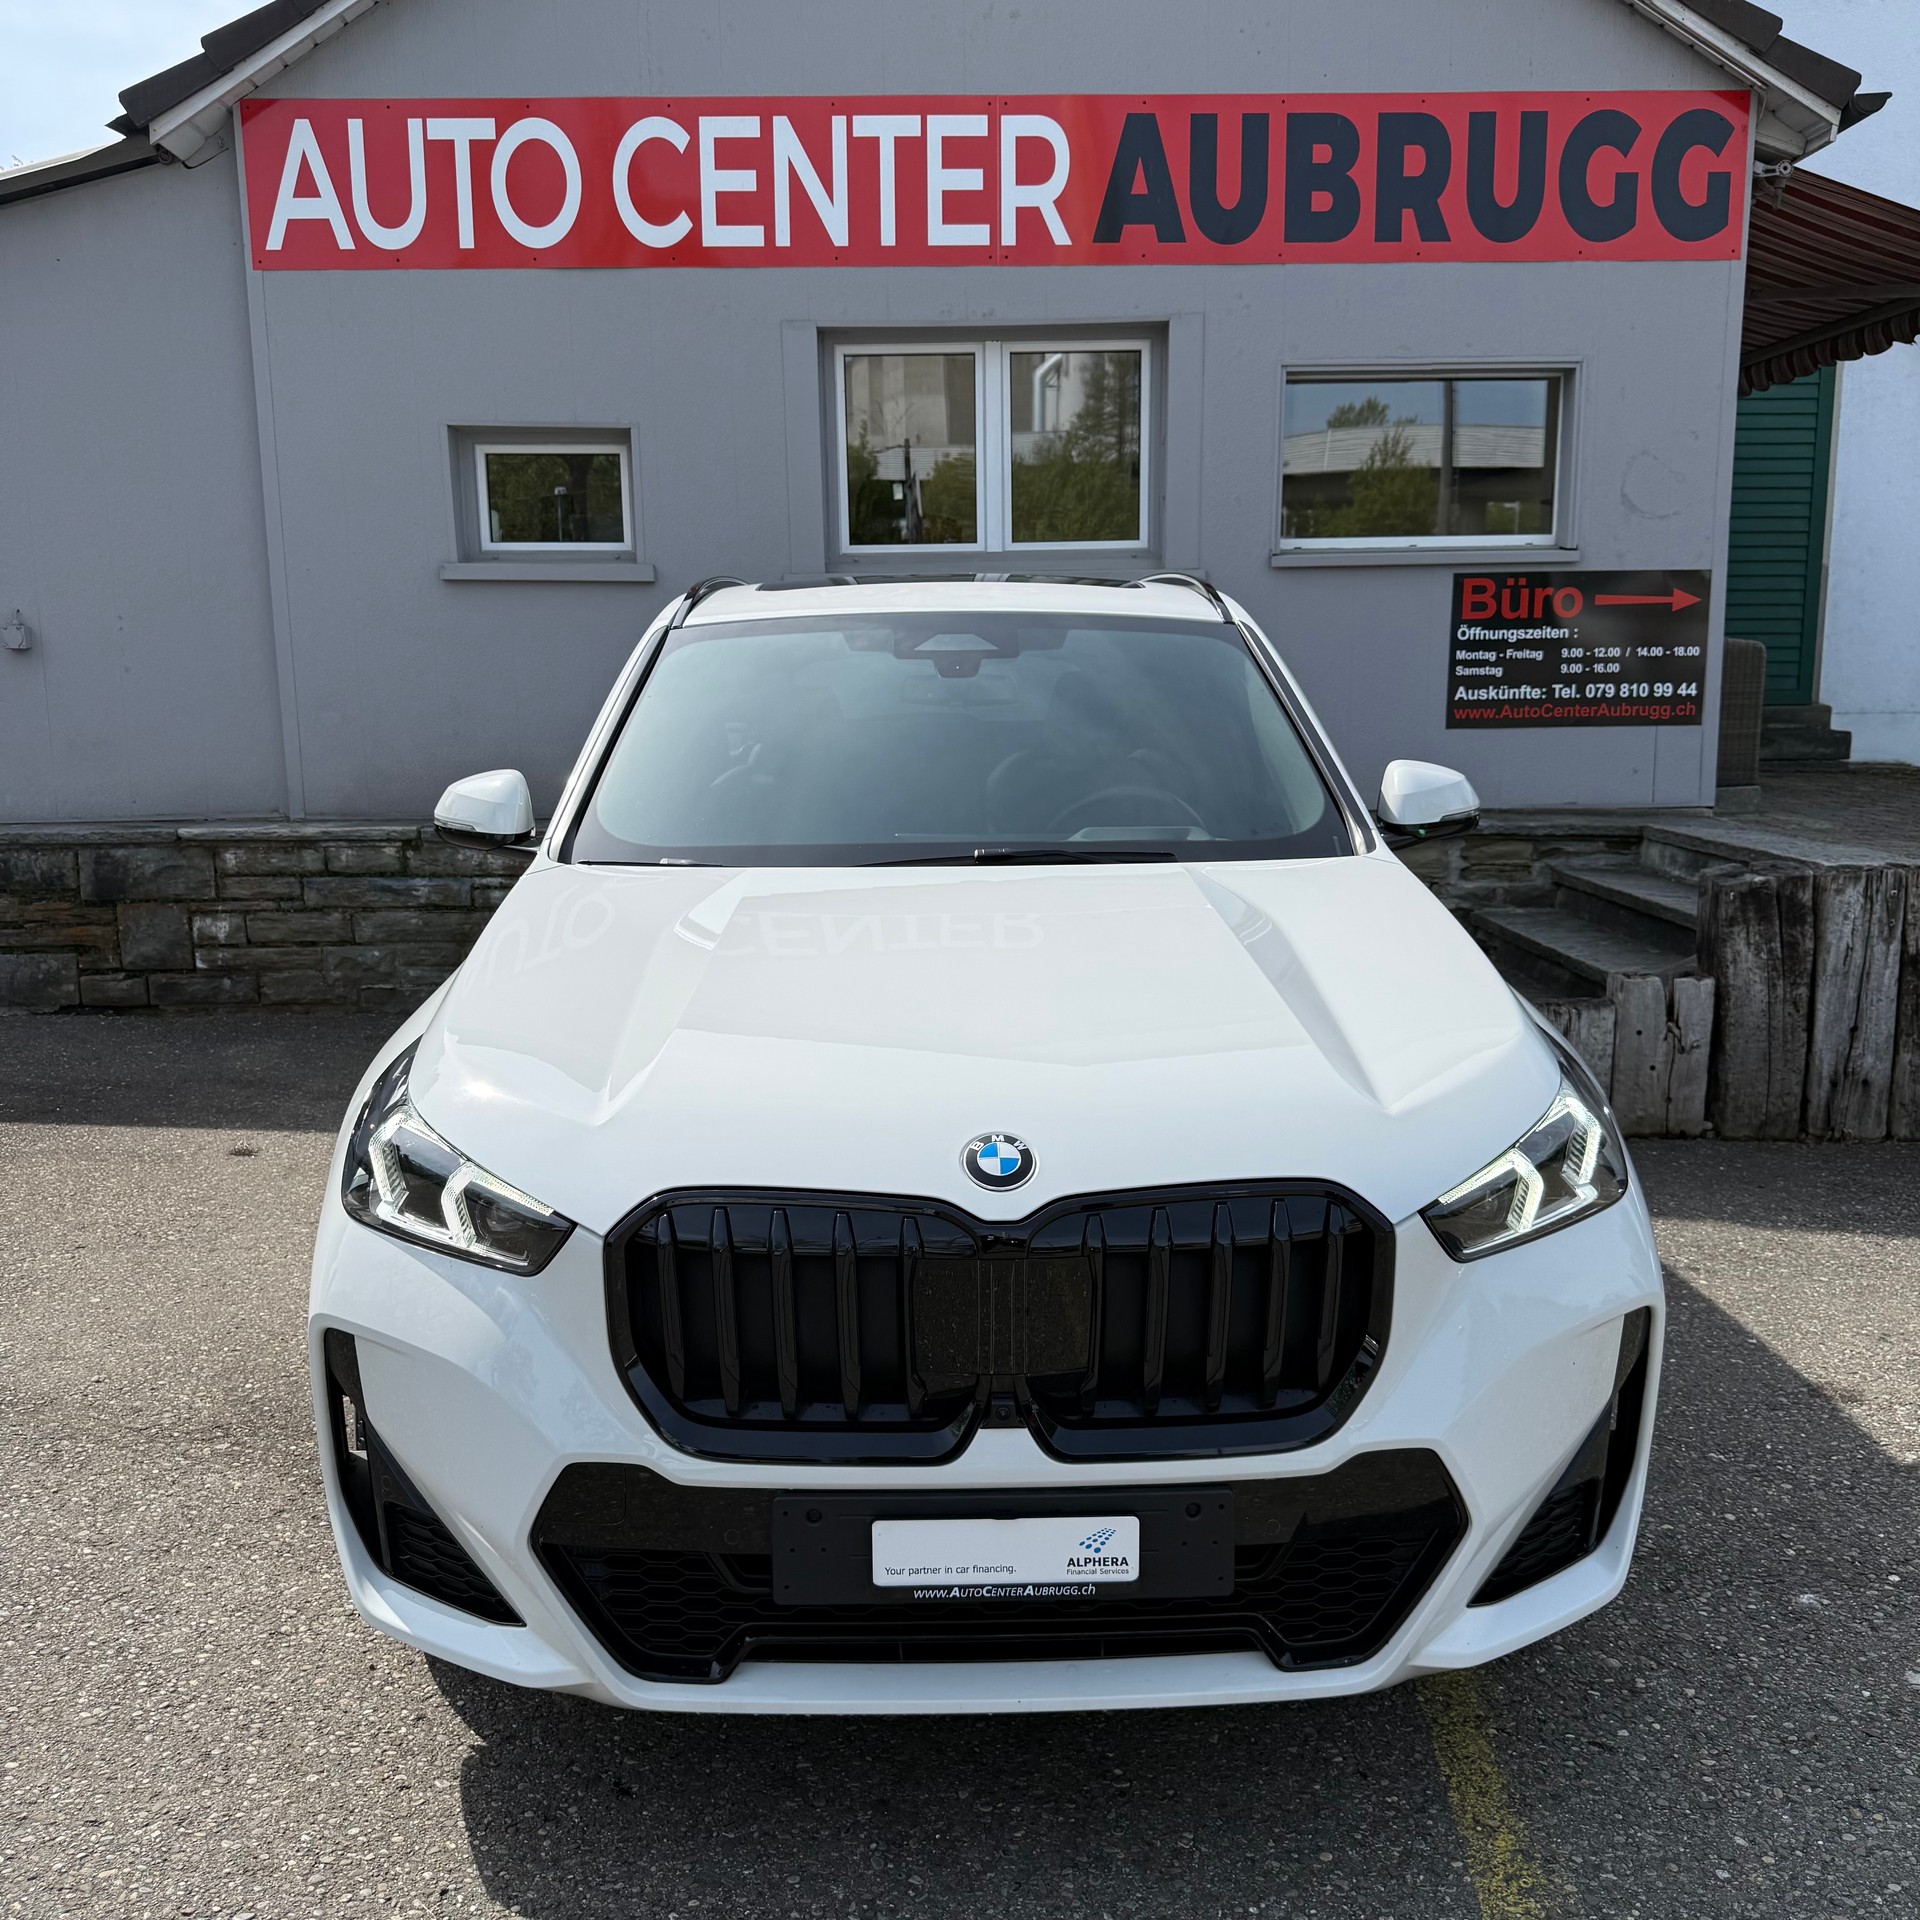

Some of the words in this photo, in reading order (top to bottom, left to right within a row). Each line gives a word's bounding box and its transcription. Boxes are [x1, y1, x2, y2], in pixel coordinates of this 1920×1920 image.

[265, 116, 582, 252] AUTO
[612, 113, 1072, 249] CENTER
[1092, 108, 1736, 246] AUBRUGG
[1461, 577, 1583, 620] Büro
[1456, 625, 1569, 643] Öffnungszeiten
[1455, 649, 1497, 662] Montag
[1506, 648, 1544, 661] Freitag
[1561, 647, 1583, 659] 9.00
[1593, 647, 1620, 658] 12.00
[1636, 646, 1663, 657] 14.00
[1673, 646, 1700, 657] 18.00
[1455, 665, 1503, 678] Samstag
[1560, 664, 1583, 674] 9.00
[1592, 663, 1620, 674] 16.00
[1454, 685, 1547, 701] Auskünfte:
[1552, 684, 1581, 699] Tel.
[1585, 683, 1614, 698] 079
[1619, 683, 1649, 698] 810
[1653, 683, 1673, 697] 99
[1677, 682, 1697, 697] 44
[1454, 702, 1696, 721] www.AutoCenterAubrugg.ch
[969, 1134, 1028, 1151] BMW
[1066, 1556, 1129, 1567] ALPHERA
[884, 1567, 904, 1575] Your
[908, 1566, 941, 1577] partner
[944, 1566, 953, 1574] in
[956, 1566, 970, 1574] car
[972, 1564, 1017, 1576] financing.
